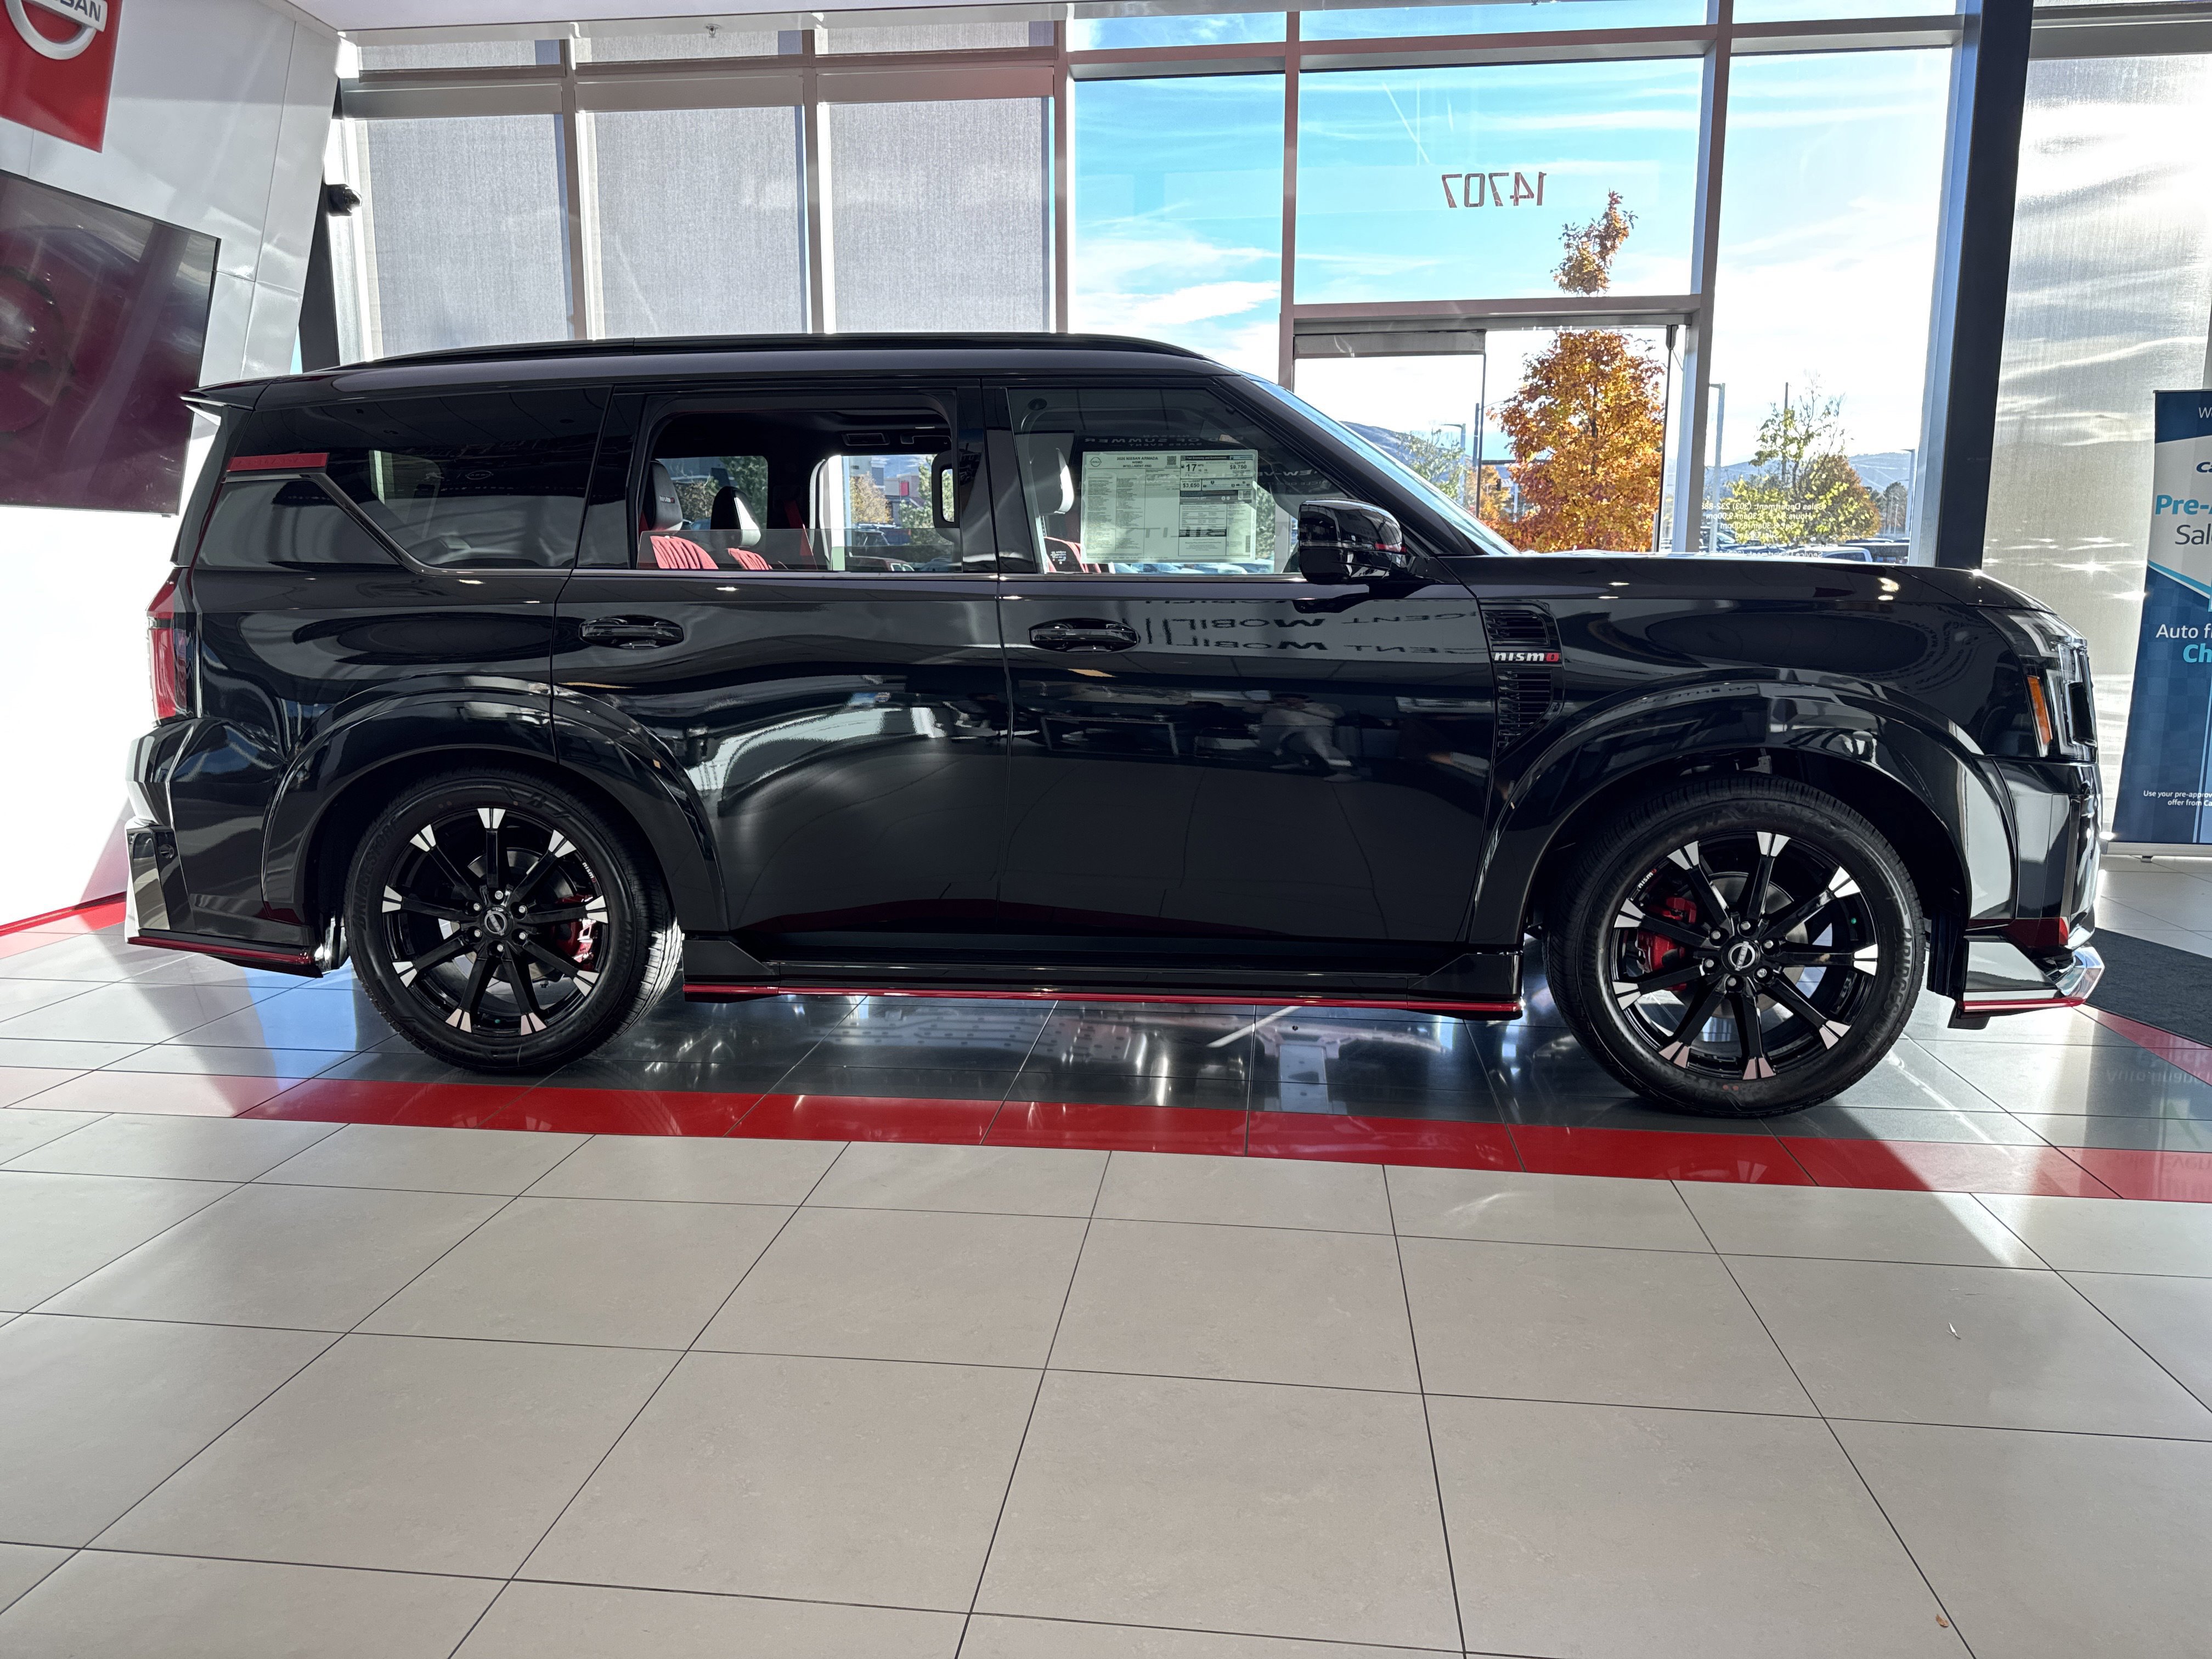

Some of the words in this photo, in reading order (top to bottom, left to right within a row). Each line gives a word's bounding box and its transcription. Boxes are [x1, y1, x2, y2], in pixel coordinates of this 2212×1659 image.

[1186, 464, 1197, 472] 17
[2155, 494, 2212, 516] Pre-
[2175, 523, 2212, 545] Sal
[2155, 624, 2199, 639] Auto
[1494, 652, 1560, 662] nismo
[582, 862, 596, 883] nismo
[1638, 868, 1657, 889] nismo
